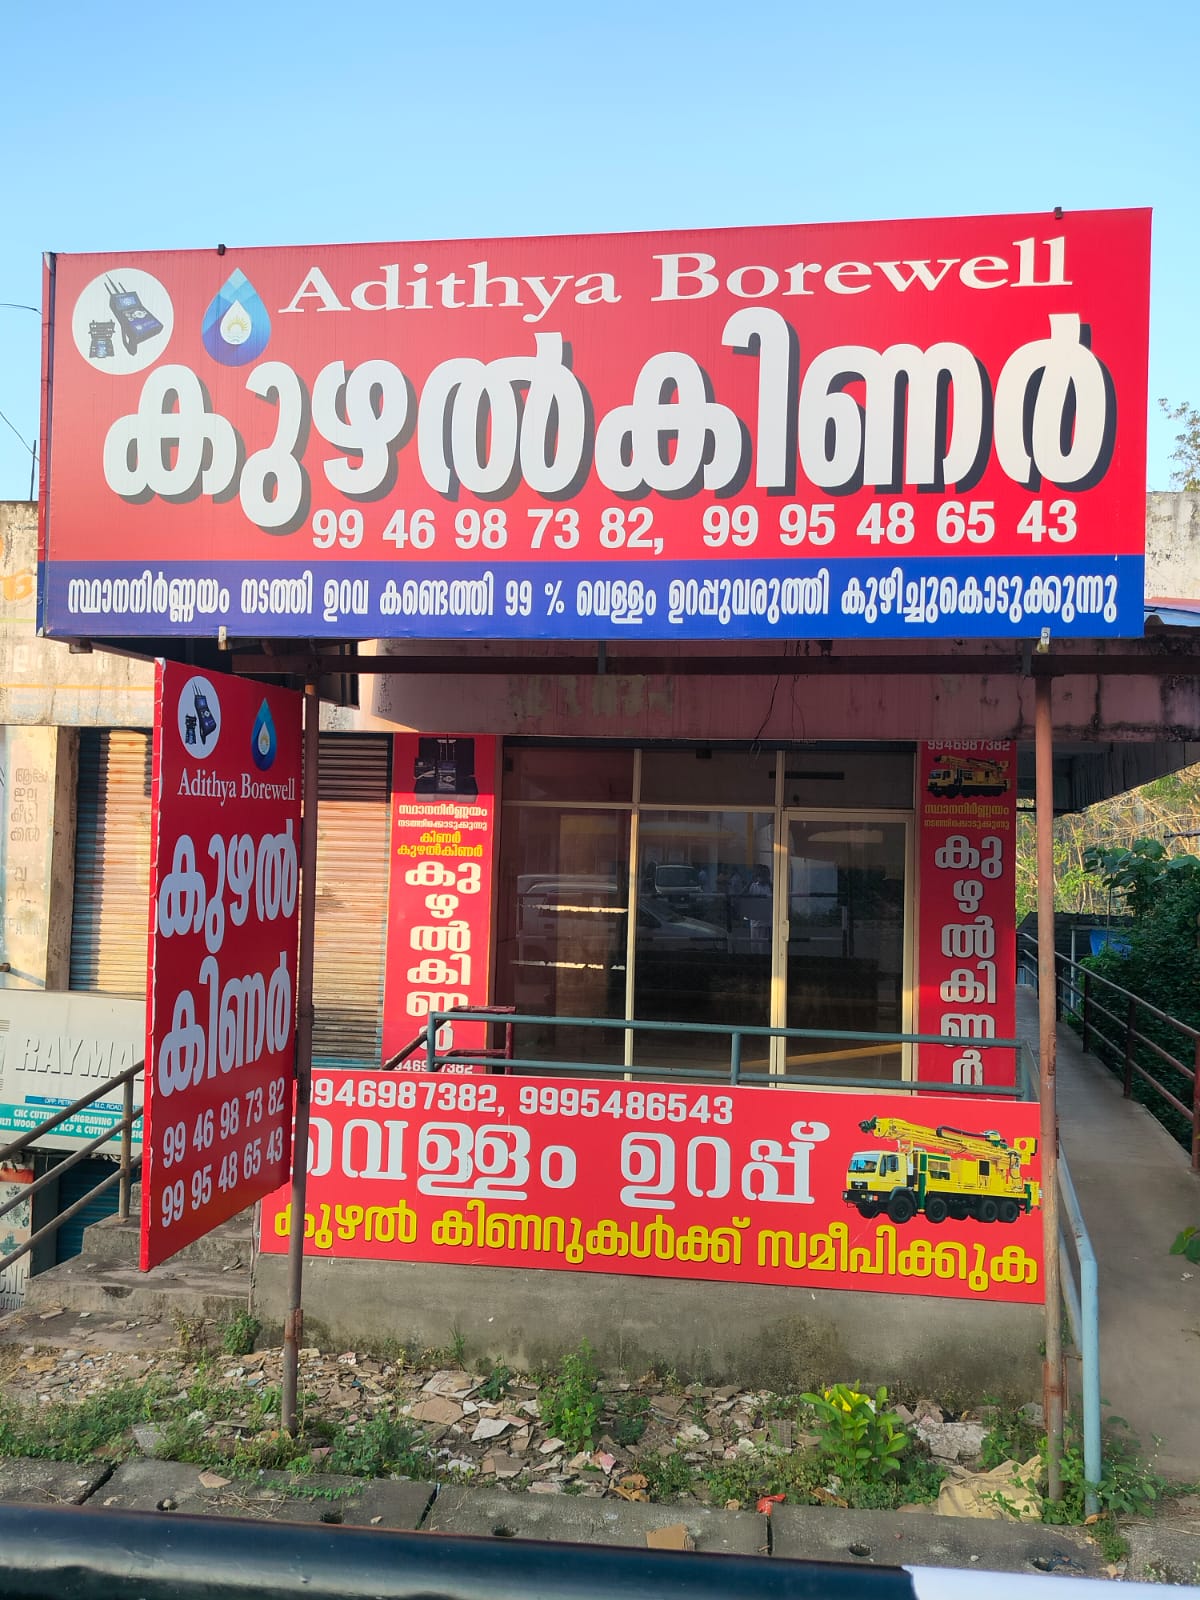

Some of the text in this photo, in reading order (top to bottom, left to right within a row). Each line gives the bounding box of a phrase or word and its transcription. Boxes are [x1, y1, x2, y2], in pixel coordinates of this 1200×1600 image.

[278, 236, 1073, 324] Adithya Borewell
[103, 307, 1108, 528] കുഴൽകിണർ
[312, 499, 1077, 555] 99 46 98 73 82, 99 95 48 65 43
[241, 569, 313, 614] നടത്തി
[323, 579, 369, 622] ഉറവ
[380, 570, 494, 616] കണ്ടെത്തി
[505, 580, 532, 616] 99
[544, 580, 565, 616] %
[576, 580, 656, 624] വെള്ളം
[668, 567, 830, 624] ഉറപ്പുവരുത്തി
[177, 768, 296, 806] Adithya Borewell
[420, 830, 462, 844] കിണർ
[158, 819, 298, 954] കുഴൽ
[16, 1035, 144, 1082] RAYMA
[158, 951, 292, 1098] കിണർ
[163, 1076, 285, 1169] 99 46 98 73 82
[310, 1078, 734, 1125] 946987382, 9995486543
[161, 1125, 284, 1228] 99 95 48 65 43
[619, 1120, 831, 1209] ഉറപ്പ്
[431, 1199, 751, 1264] കിണറുകൾക്ക്
[757, 1221, 1038, 1292] സമീപിക്കുക
